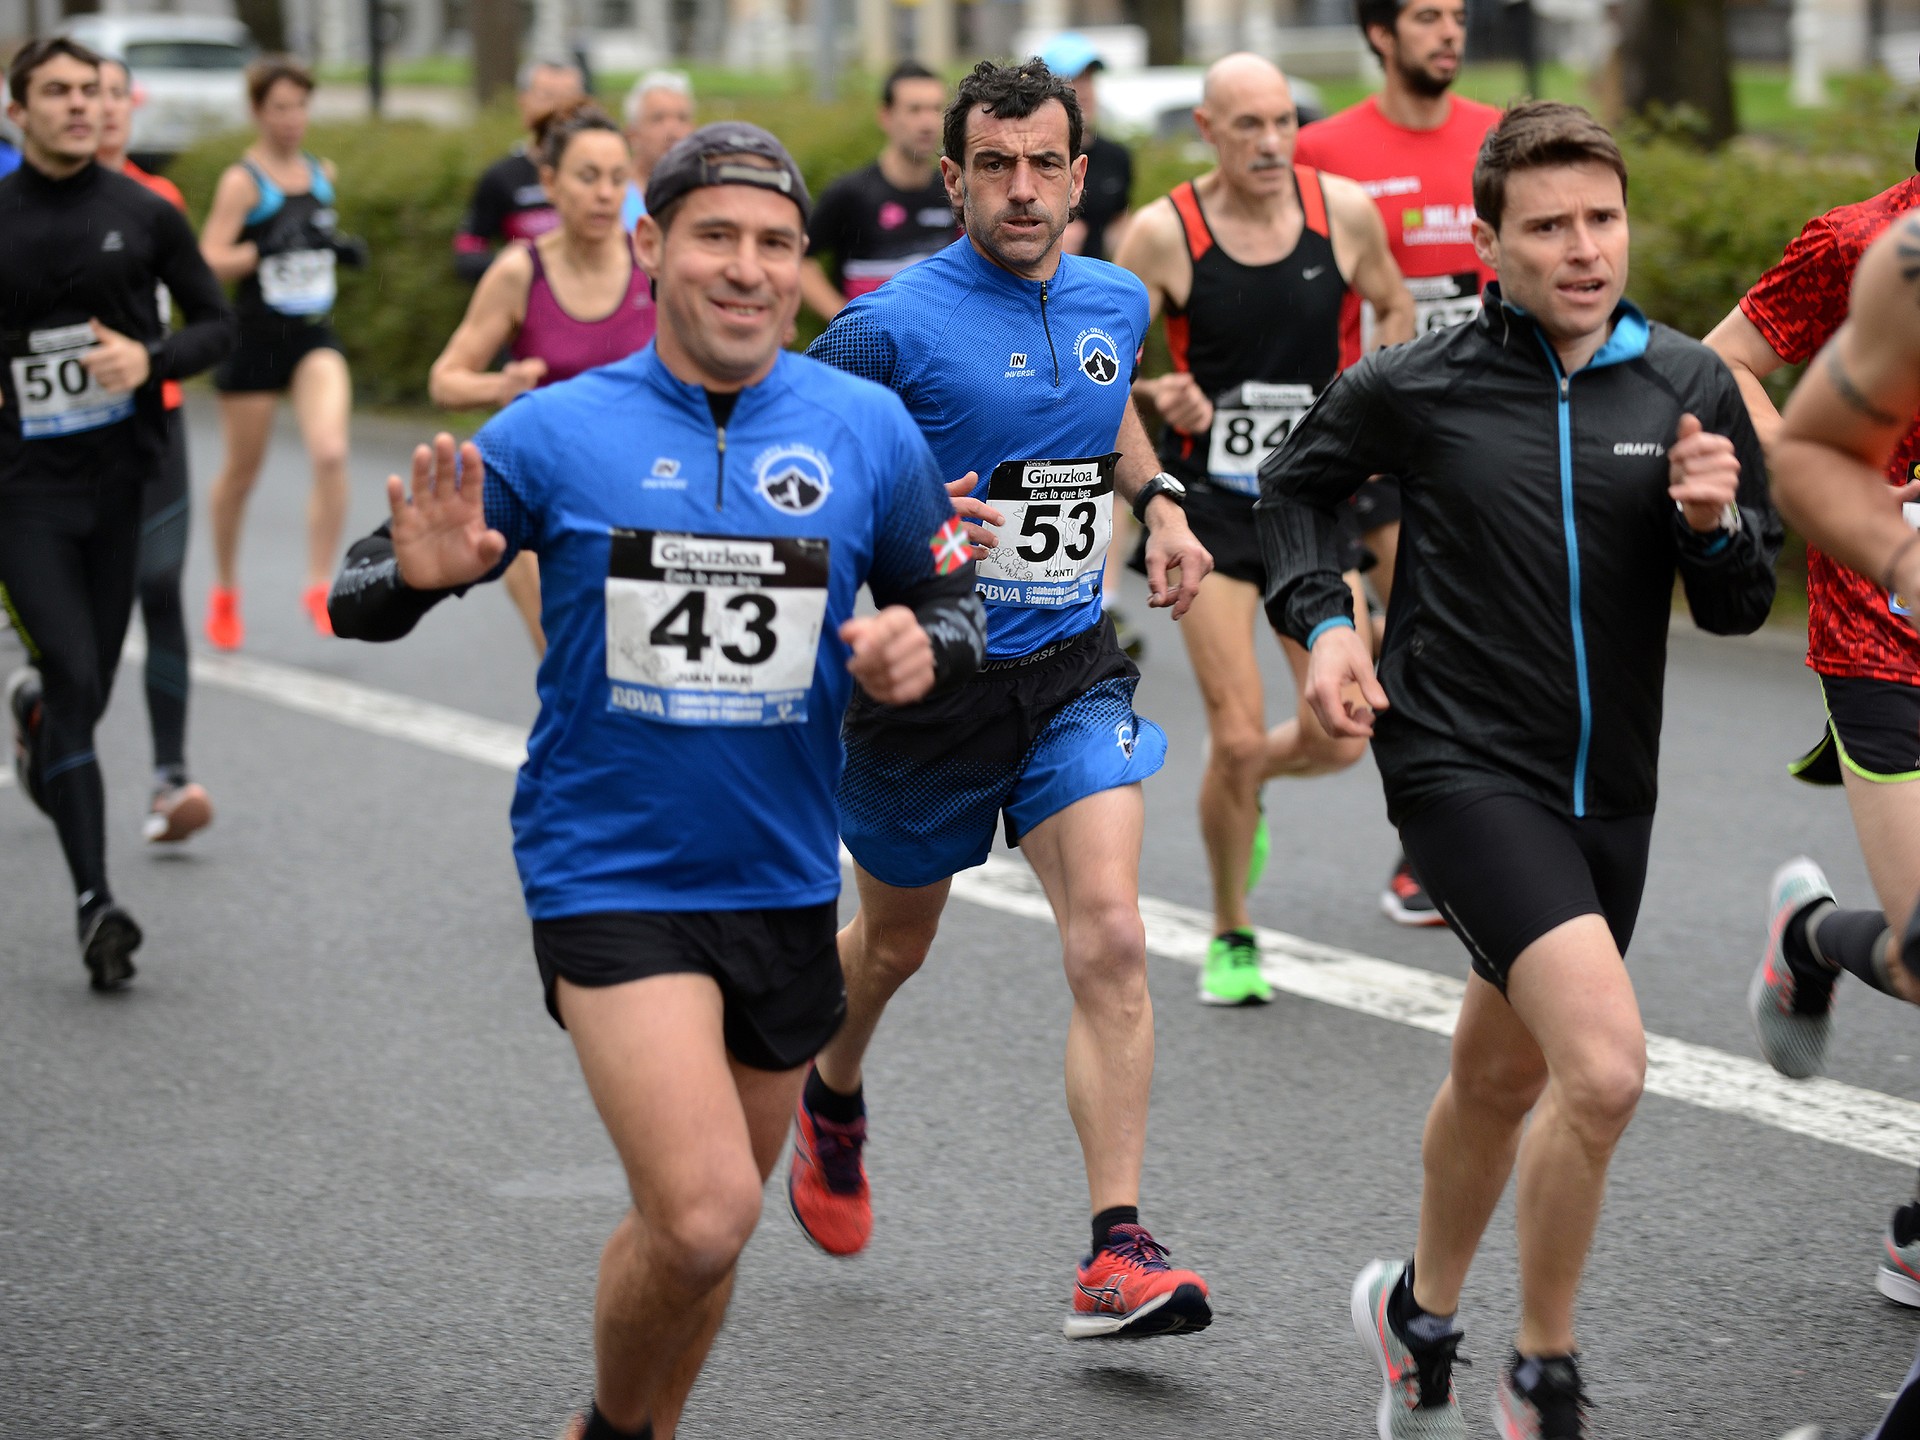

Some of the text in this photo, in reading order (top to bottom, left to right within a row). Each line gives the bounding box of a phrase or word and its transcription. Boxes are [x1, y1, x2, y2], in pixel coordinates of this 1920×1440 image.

[1004, 369, 1036, 378] INVERSE
[1225, 417, 1291, 455] 84
[1613, 442, 1656, 456] CRAFT
[1027, 468, 1092, 488] Gipuzkoa
[1030, 488, 1091, 501] Eres lo que lees
[1016, 502, 1096, 562] 53
[661, 543, 762, 568] Gipuzkoa
[1045, 568, 1074, 578] XANTI
[975, 583, 1021, 603] BBVA
[650, 590, 777, 665] 43
[675, 672, 712, 684] JUAN
[611, 685, 665, 717] BBVA
